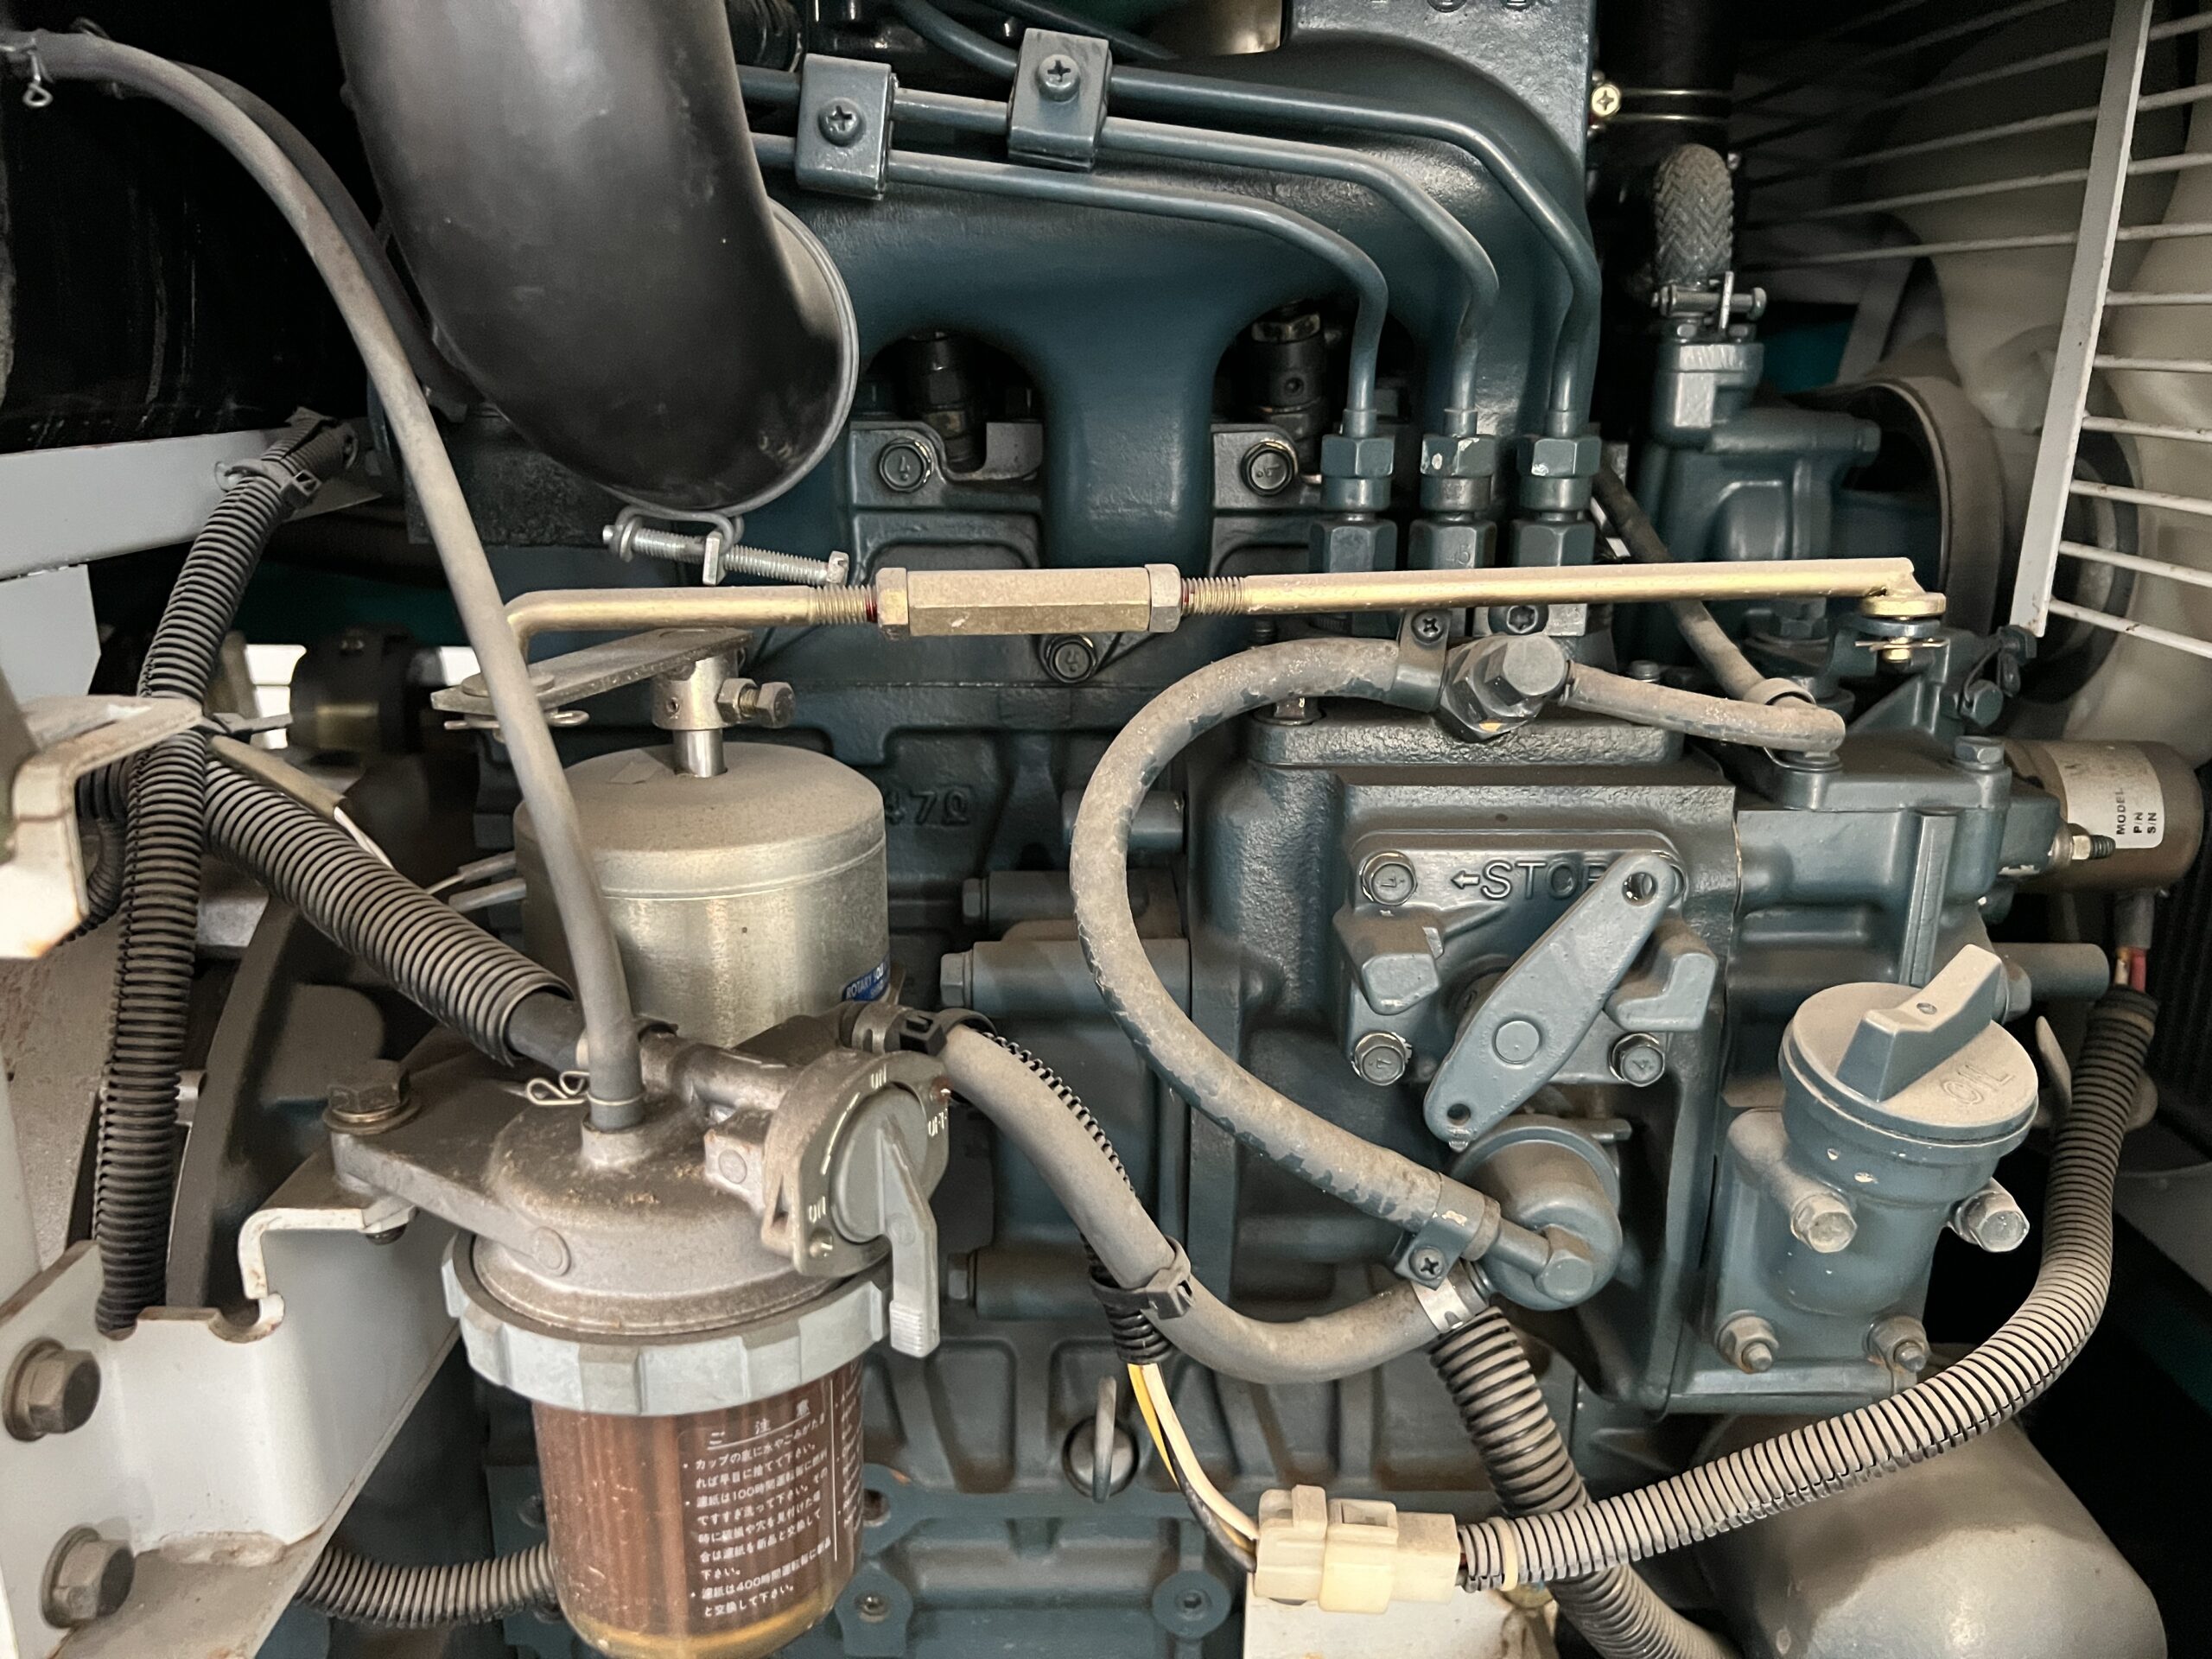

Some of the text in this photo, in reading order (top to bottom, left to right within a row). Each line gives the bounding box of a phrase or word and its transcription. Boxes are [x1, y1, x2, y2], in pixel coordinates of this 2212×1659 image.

[2114, 787, 2126, 835] MODEL
[2133, 811, 2144, 834] P/N
[2146, 811, 2158, 834] S/N
[1940, 1065, 2015, 1105] OIL
